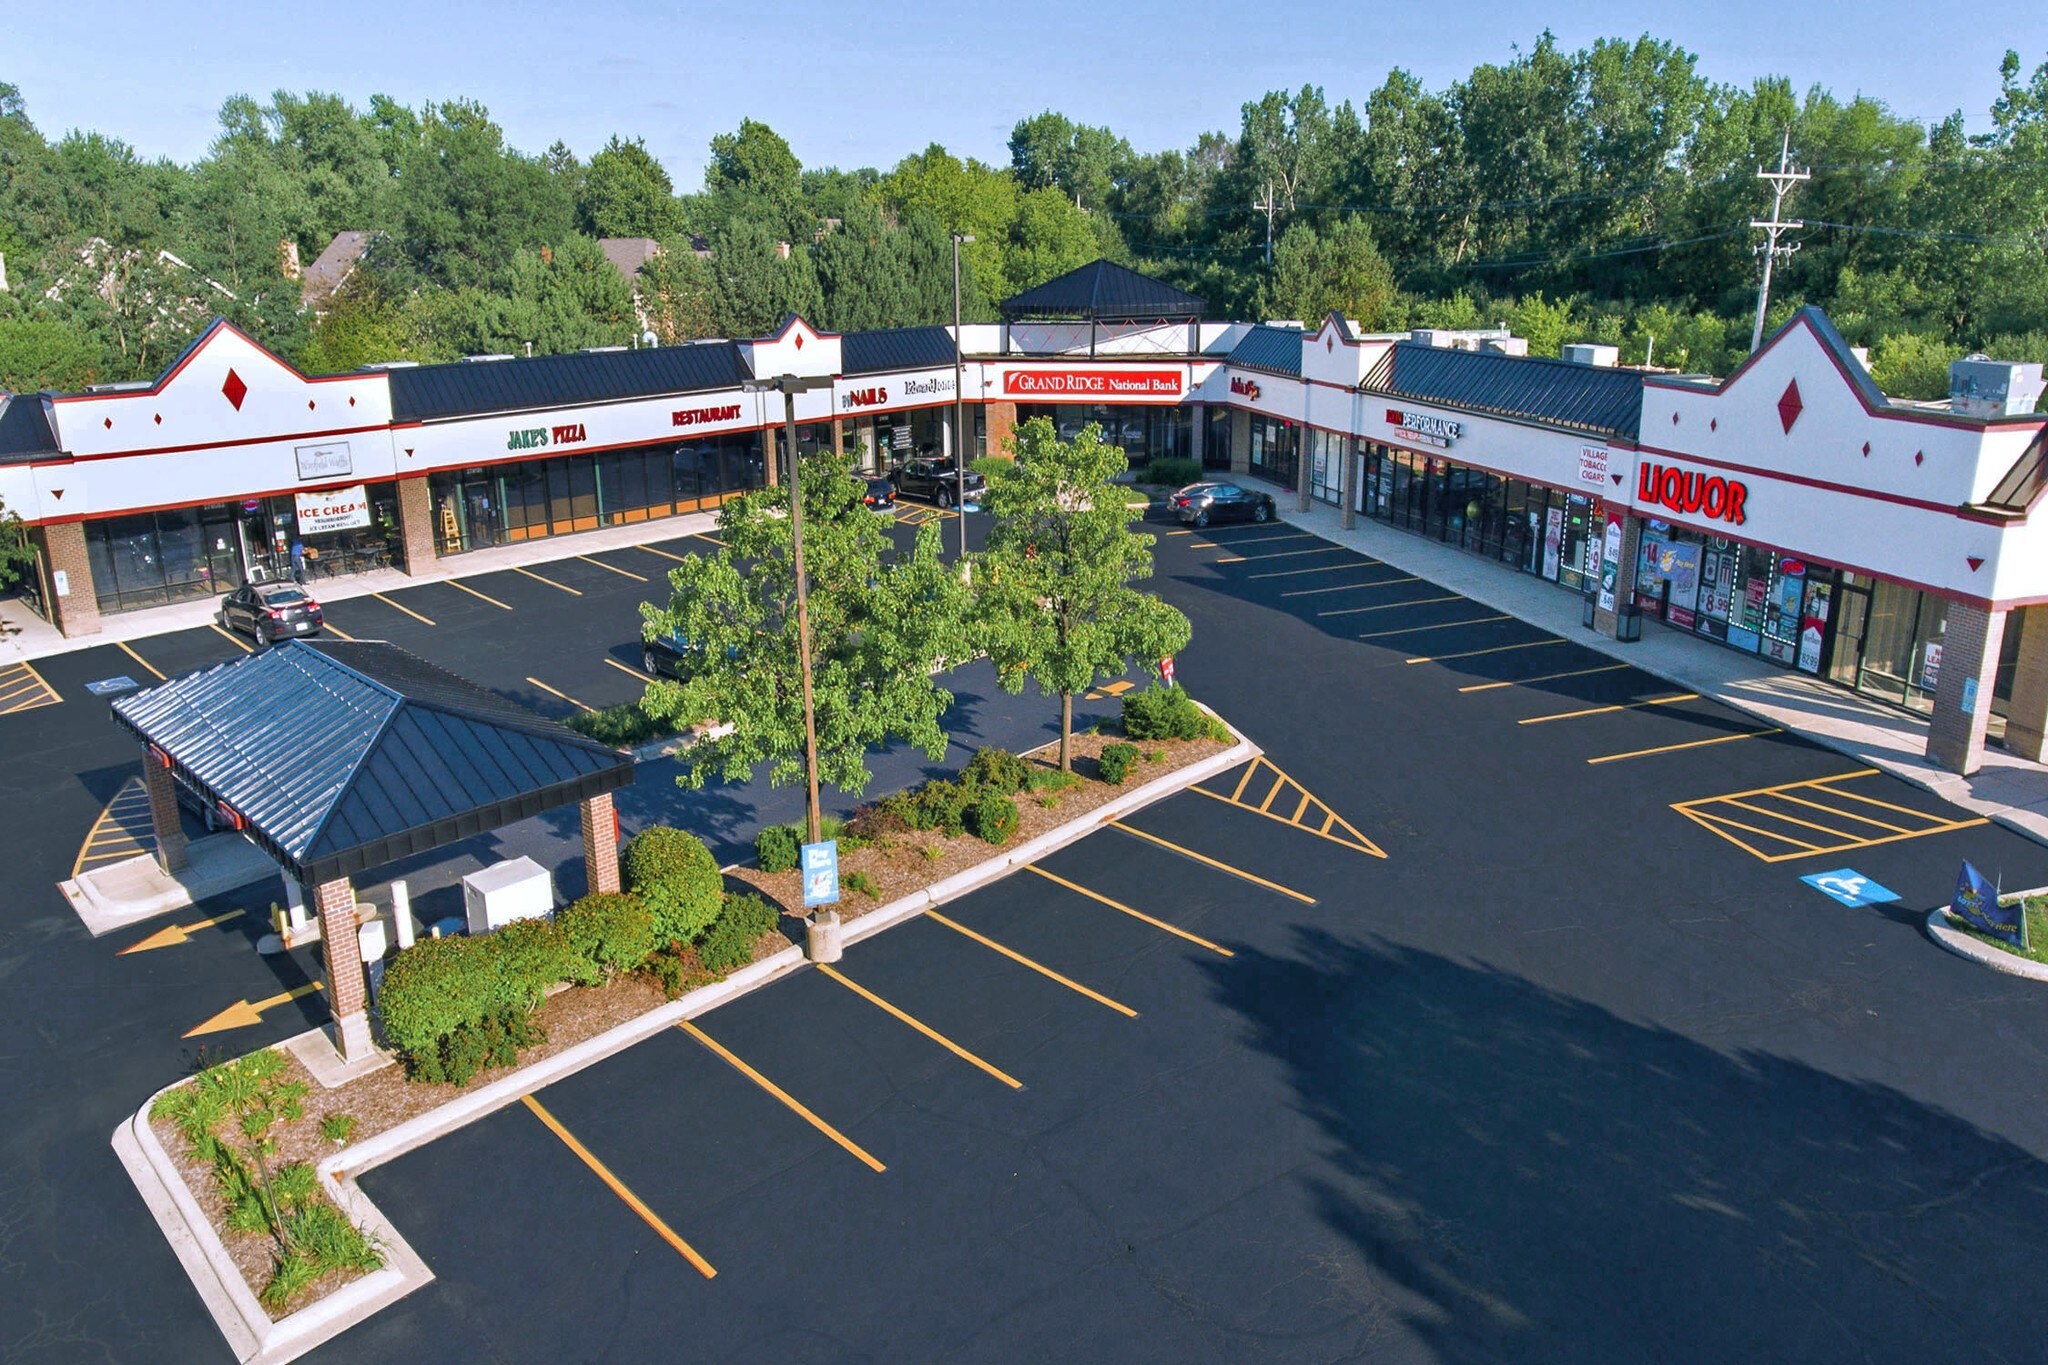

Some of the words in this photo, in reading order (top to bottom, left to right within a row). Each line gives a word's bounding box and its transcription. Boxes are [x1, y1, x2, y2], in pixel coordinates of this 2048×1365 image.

[1019, 374, 1065, 390] GRAND
[1066, 375, 1104, 390] RIDGE
[1109, 379, 1150, 391] National
[1153, 379, 1178, 391] Bank
[849, 387, 888, 407] NAILS
[671, 404, 741, 427] RESTAURANT
[1402, 412, 1459, 439] PERFORMANCE
[507, 427, 548, 450] JAKE'S
[551, 423, 587, 445] PIZZA
[1582, 448, 1608, 461] VILLAGE
[1581, 470, 1605, 483] CIGARS
[1638, 461, 1748, 526] LIQUOR
[299, 508, 320, 519] ICE
[322, 501, 367, 516] CREAM
